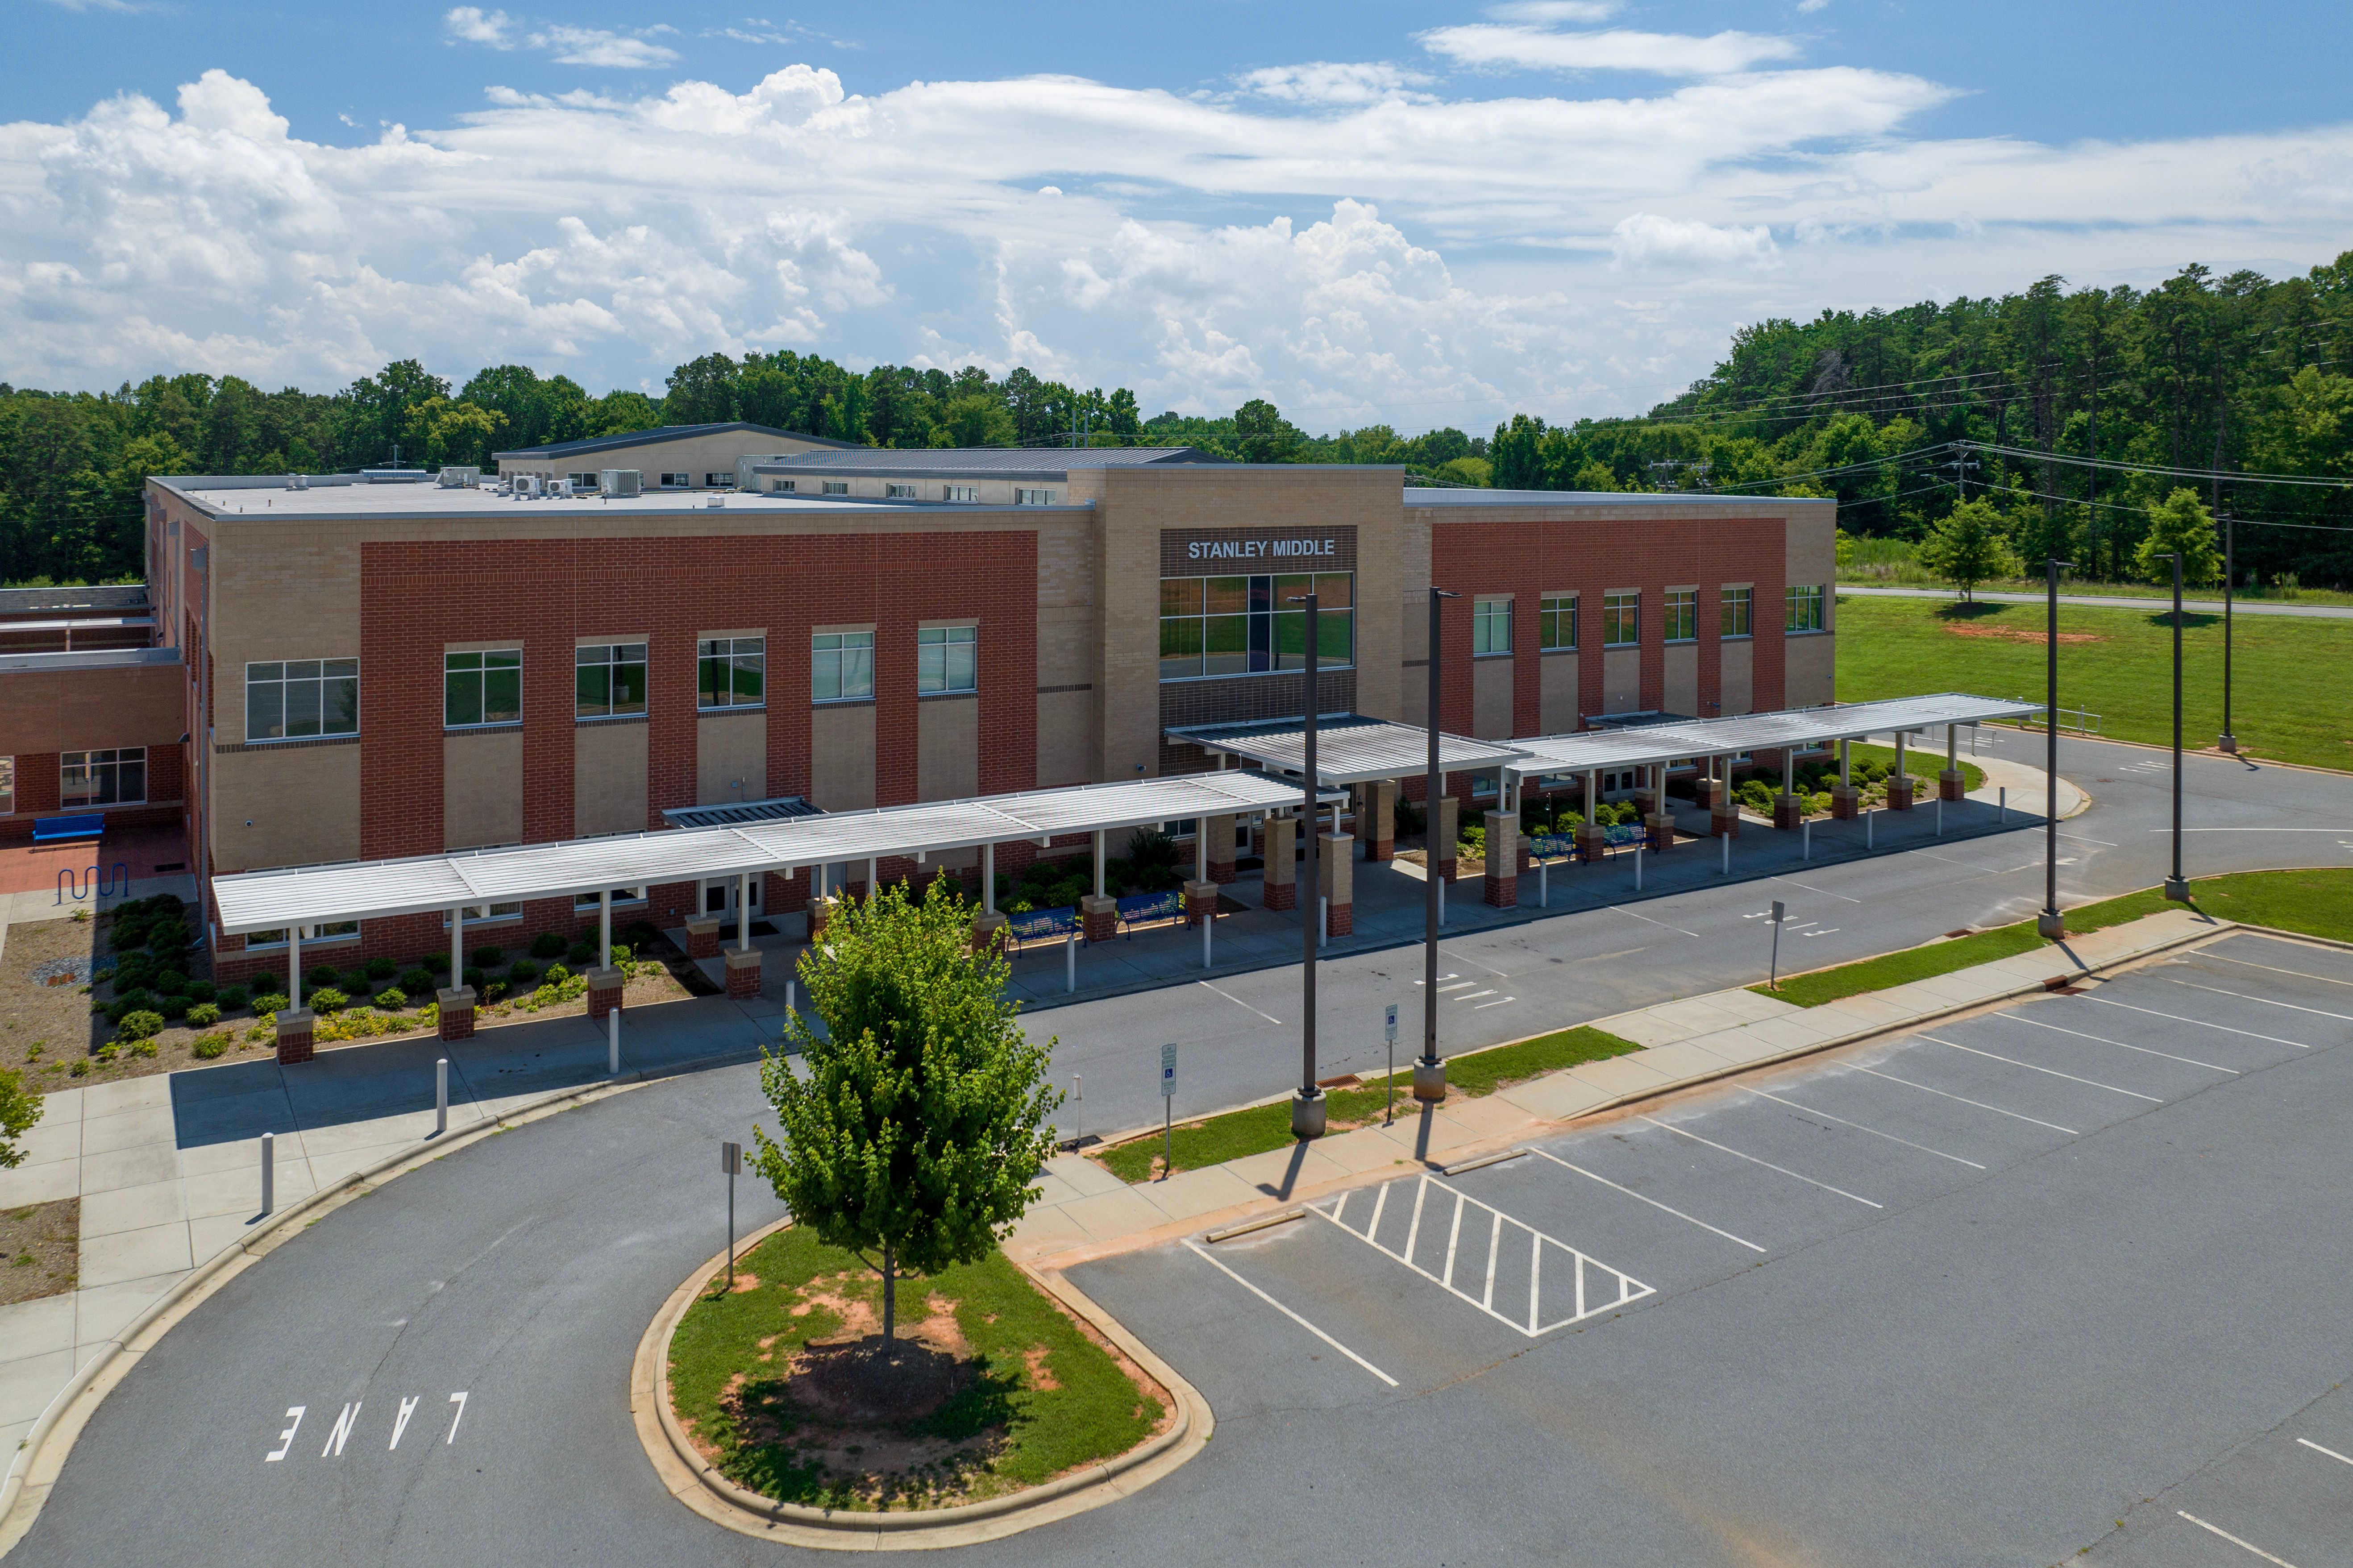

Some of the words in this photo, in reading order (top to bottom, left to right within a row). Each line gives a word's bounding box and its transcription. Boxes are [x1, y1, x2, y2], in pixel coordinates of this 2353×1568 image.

[1188, 541, 1268, 559] STANLEY
[1272, 539, 1335, 556] MIDDLE
[1742, 909, 1841, 937] FIRE
[1413, 973, 1516, 1009] LANE
[265, 1391, 469, 1462] LANE
